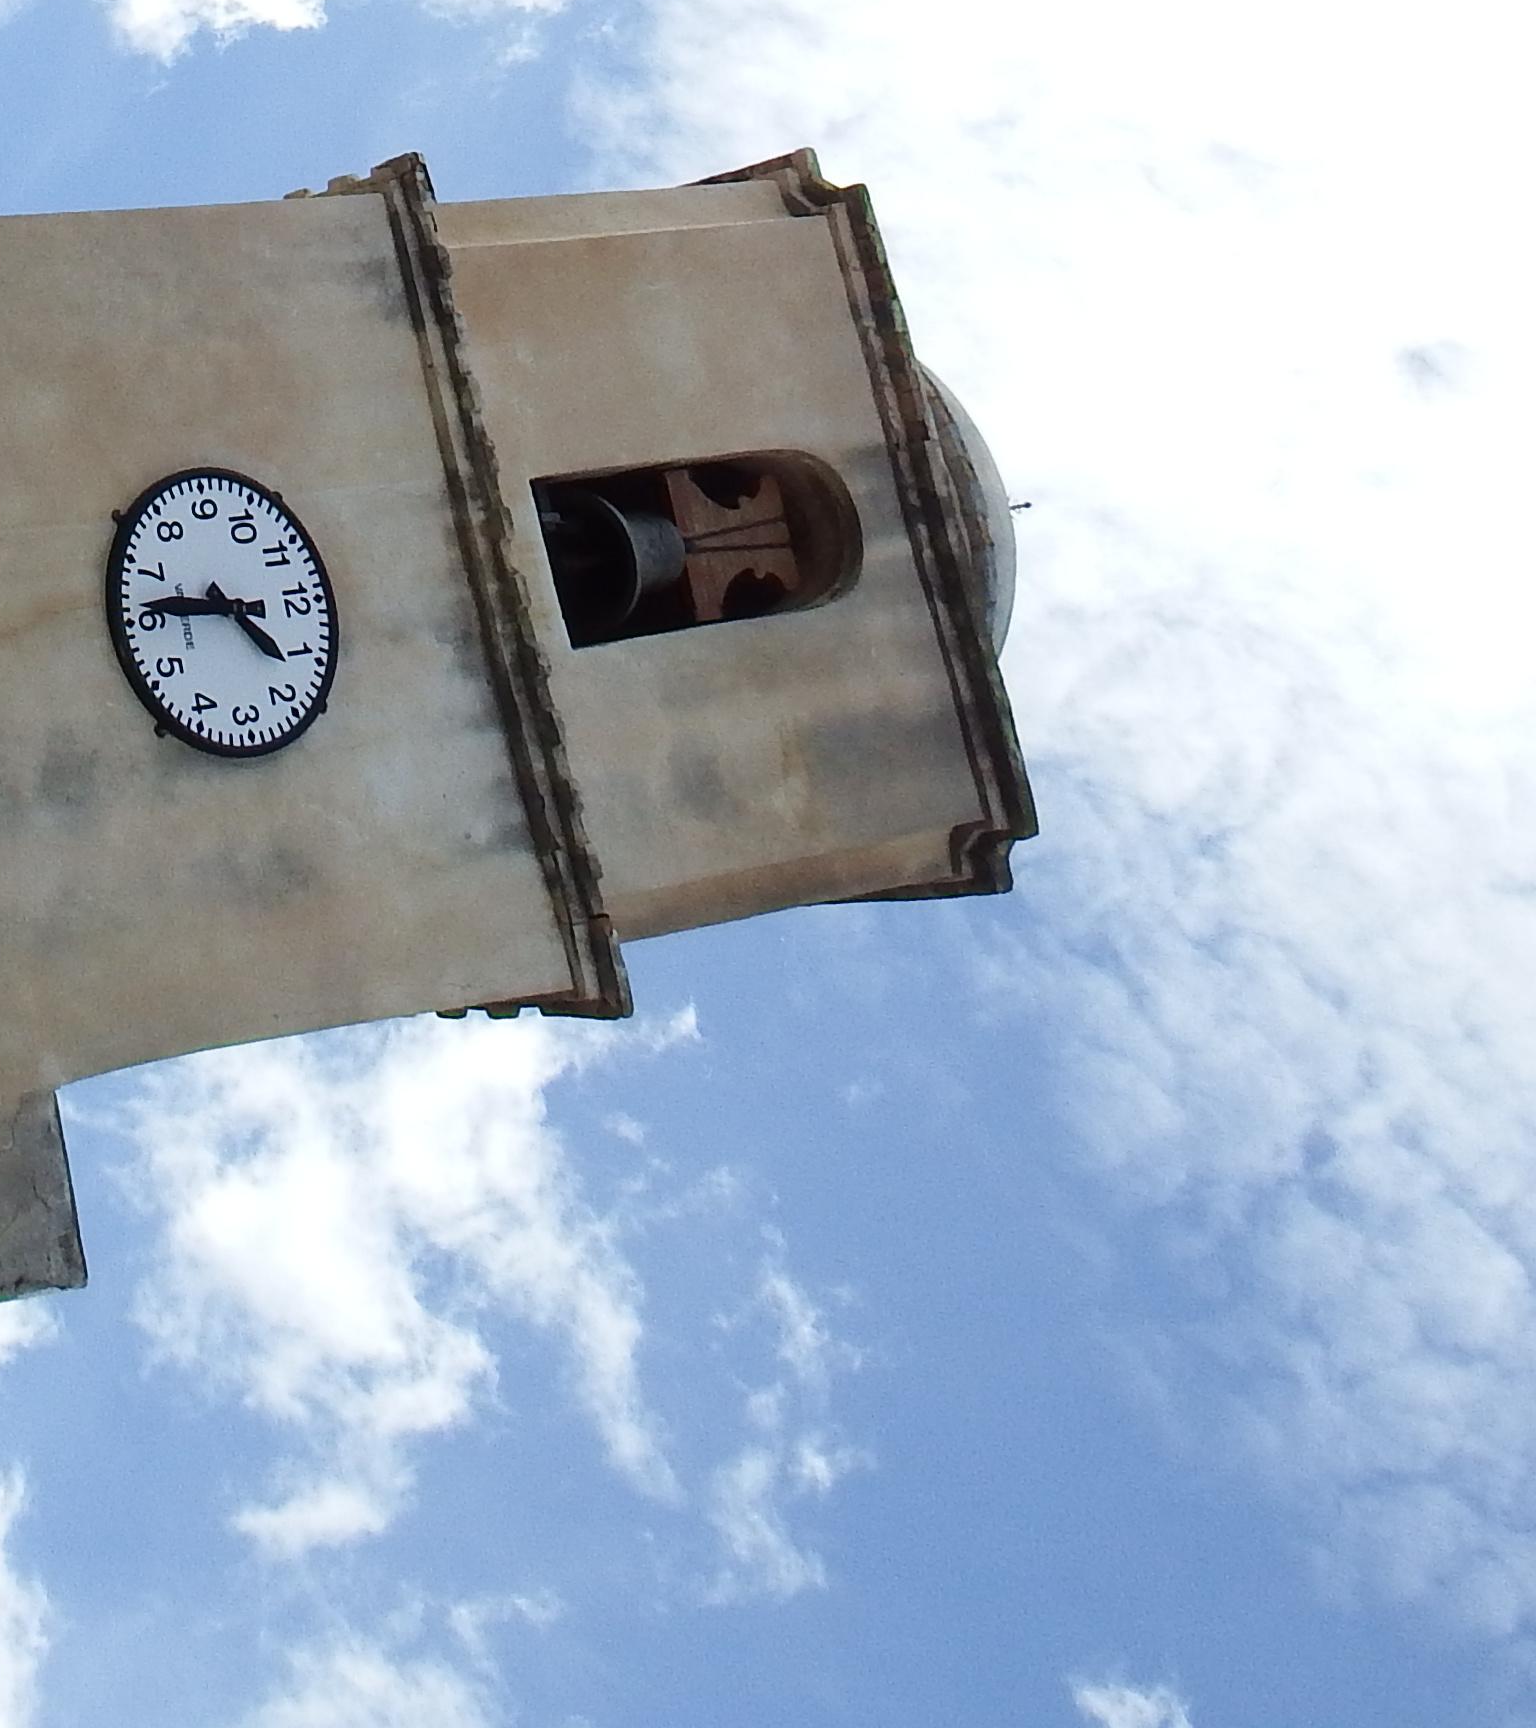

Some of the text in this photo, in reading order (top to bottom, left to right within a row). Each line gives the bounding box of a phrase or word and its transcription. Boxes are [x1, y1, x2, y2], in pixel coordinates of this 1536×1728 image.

[191, 499, 217, 520] 9
[157, 521, 184, 542] 8
[229, 509, 257, 543] 10
[262, 541, 290, 567] 11
[138, 562, 165, 582] 7
[281, 582, 310, 617] 12
[139, 610, 165, 631] 6
[174, 583, 195, 650] VAERDE
[287, 642, 312, 658] 1
[156, 657, 184, 678] 5
[191, 693, 217, 713] 4
[268, 684, 296, 705] 2
[233, 705, 259, 726] 3
